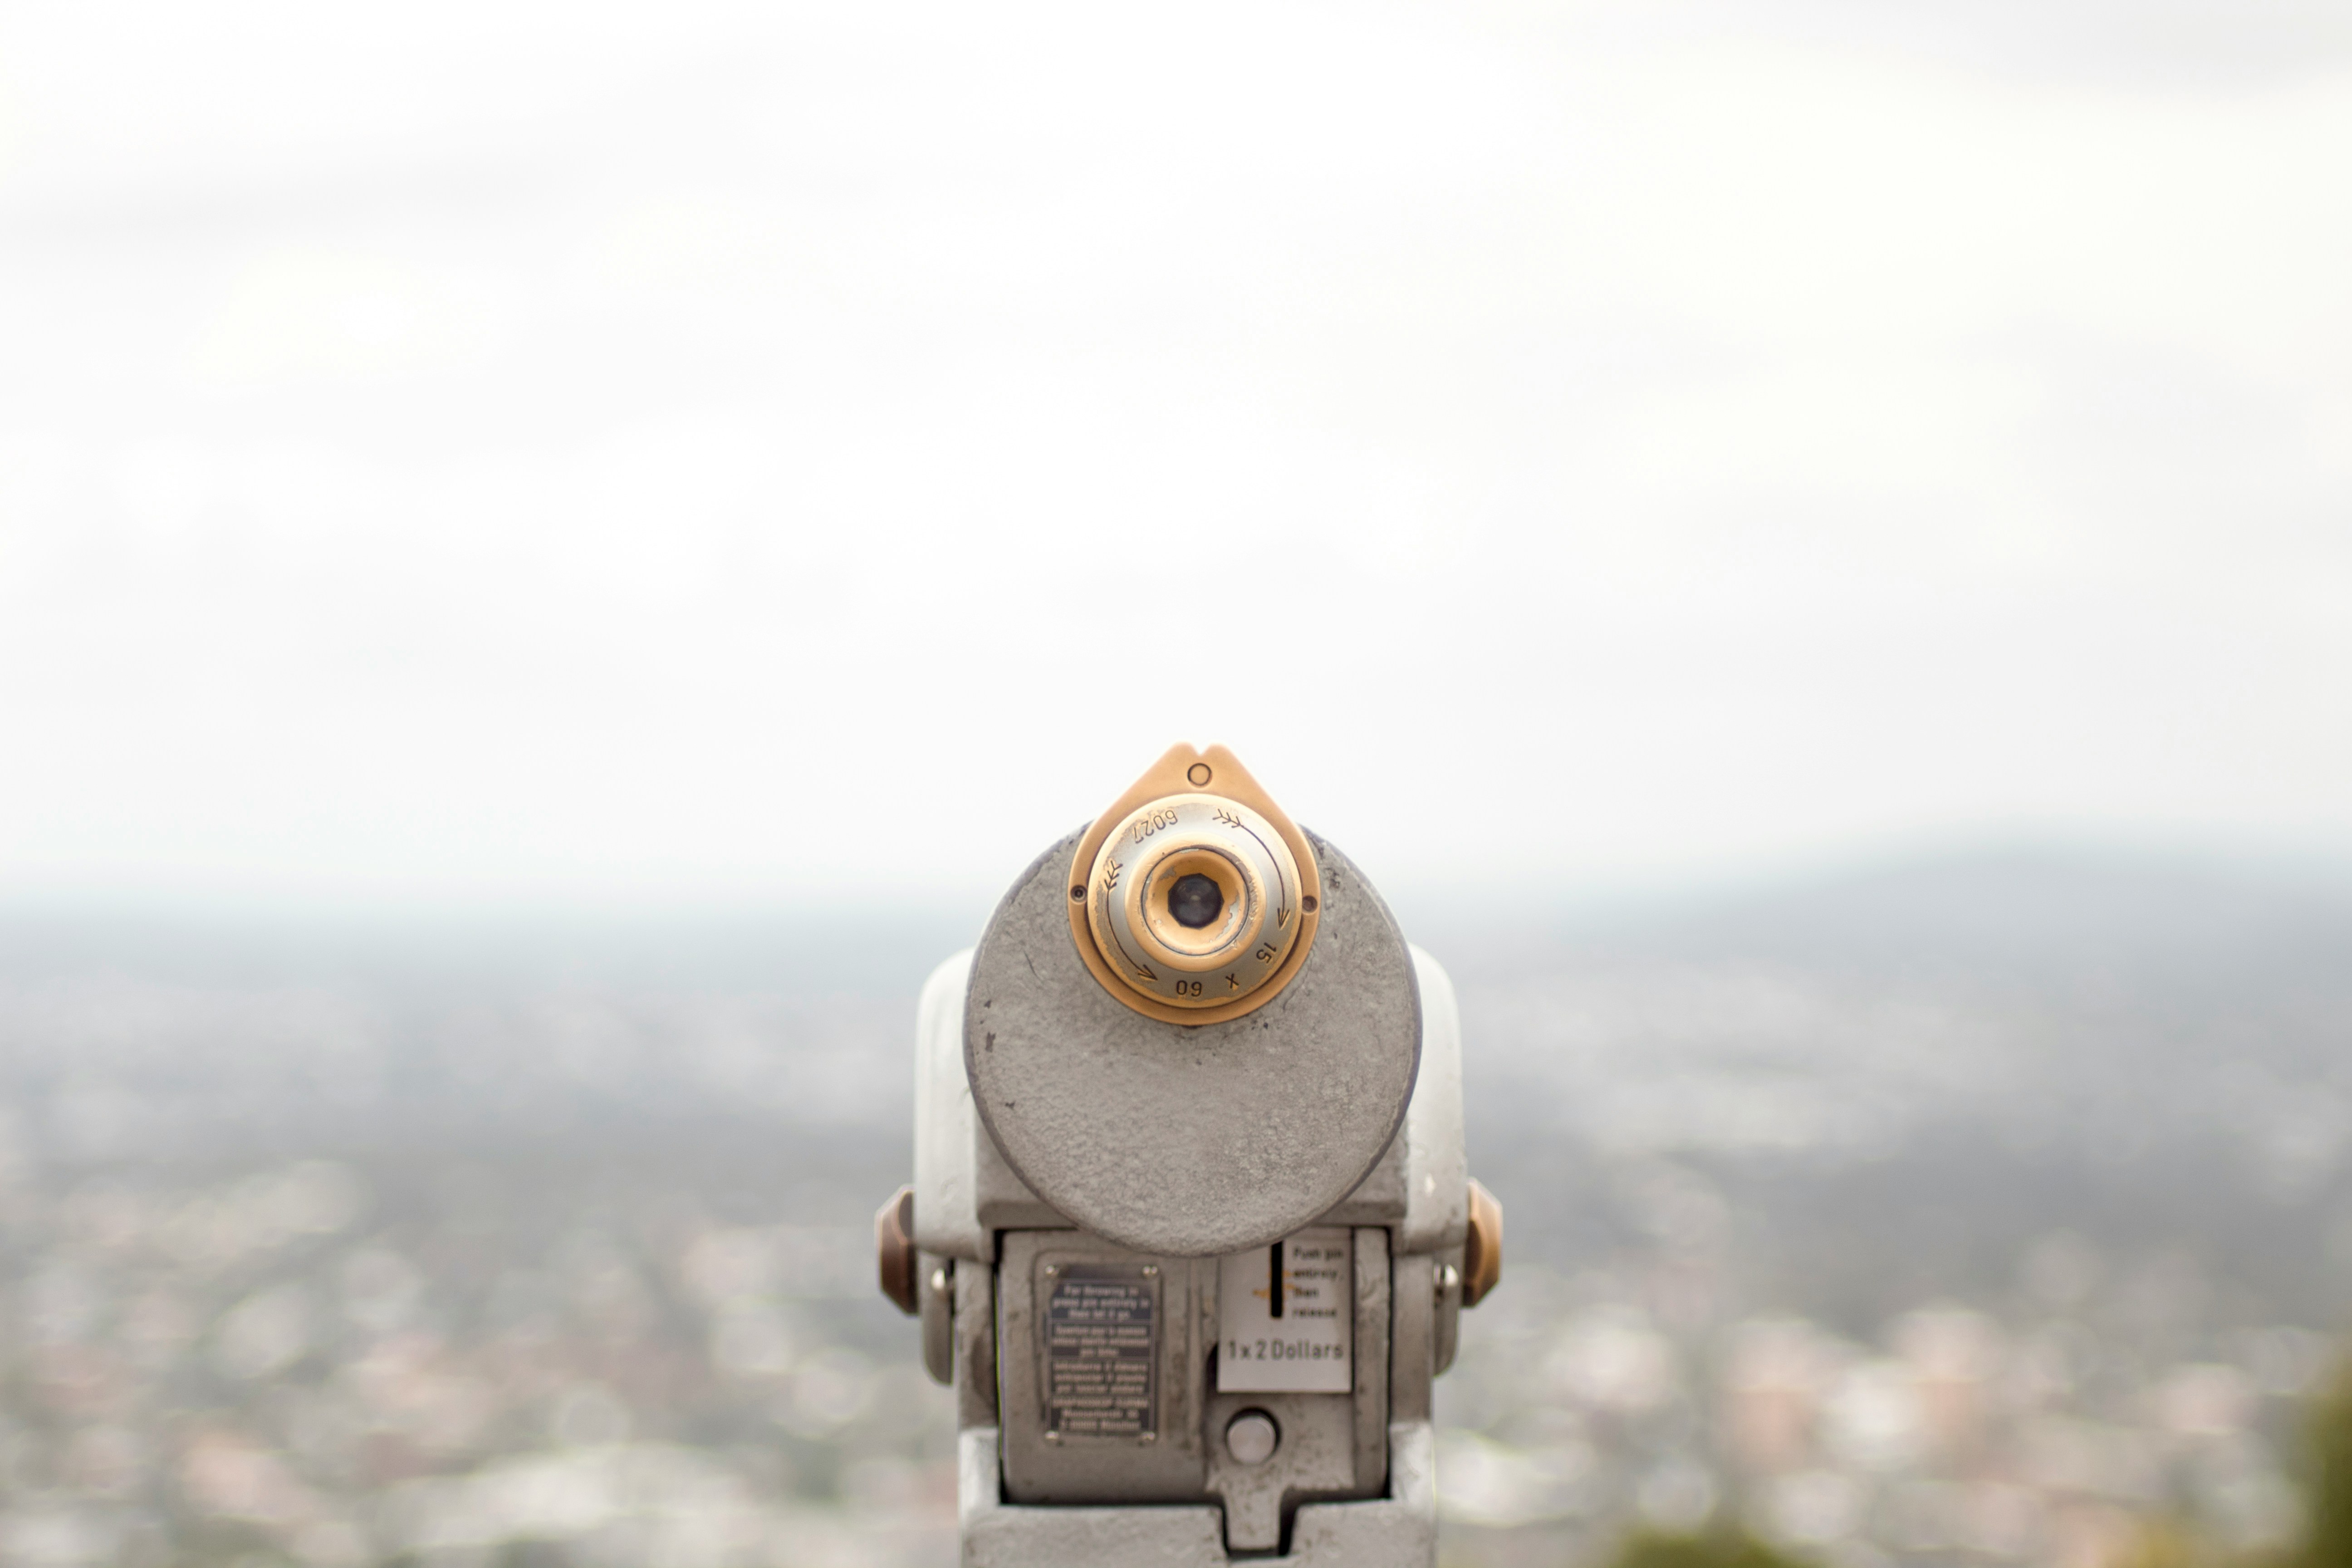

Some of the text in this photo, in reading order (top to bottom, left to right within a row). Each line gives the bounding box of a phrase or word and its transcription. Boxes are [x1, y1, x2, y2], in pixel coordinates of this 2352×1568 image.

[1133, 810, 1178, 844] 6027
[1256, 942, 1277, 964] 15
[1176, 980, 1202, 997] 60
[1271, 1339, 1343, 1360] Dollars
